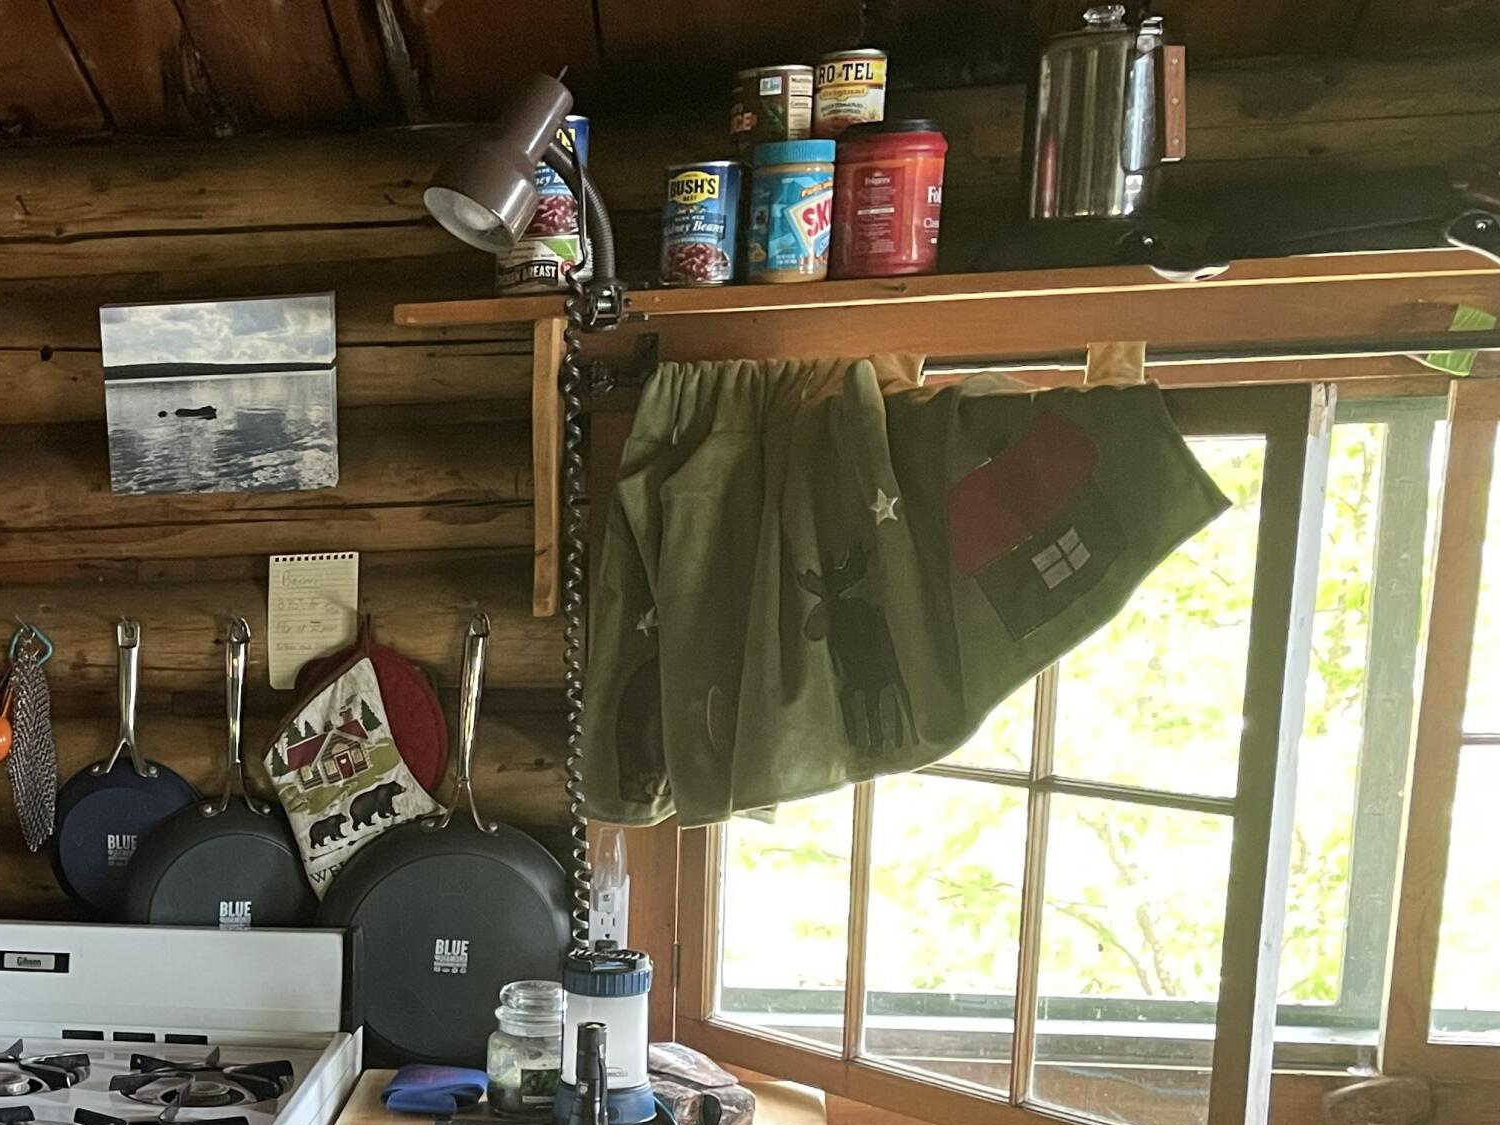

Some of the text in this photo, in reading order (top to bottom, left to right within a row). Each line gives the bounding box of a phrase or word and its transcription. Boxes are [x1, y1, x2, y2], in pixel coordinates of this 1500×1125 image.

[670, 177, 717, 198] BUSH'S
[692, 220, 725, 233] Beans
[107, 834, 138, 850] BLUE
[219, 901, 252, 917] BLUE
[435, 938, 470, 956] BLUE
